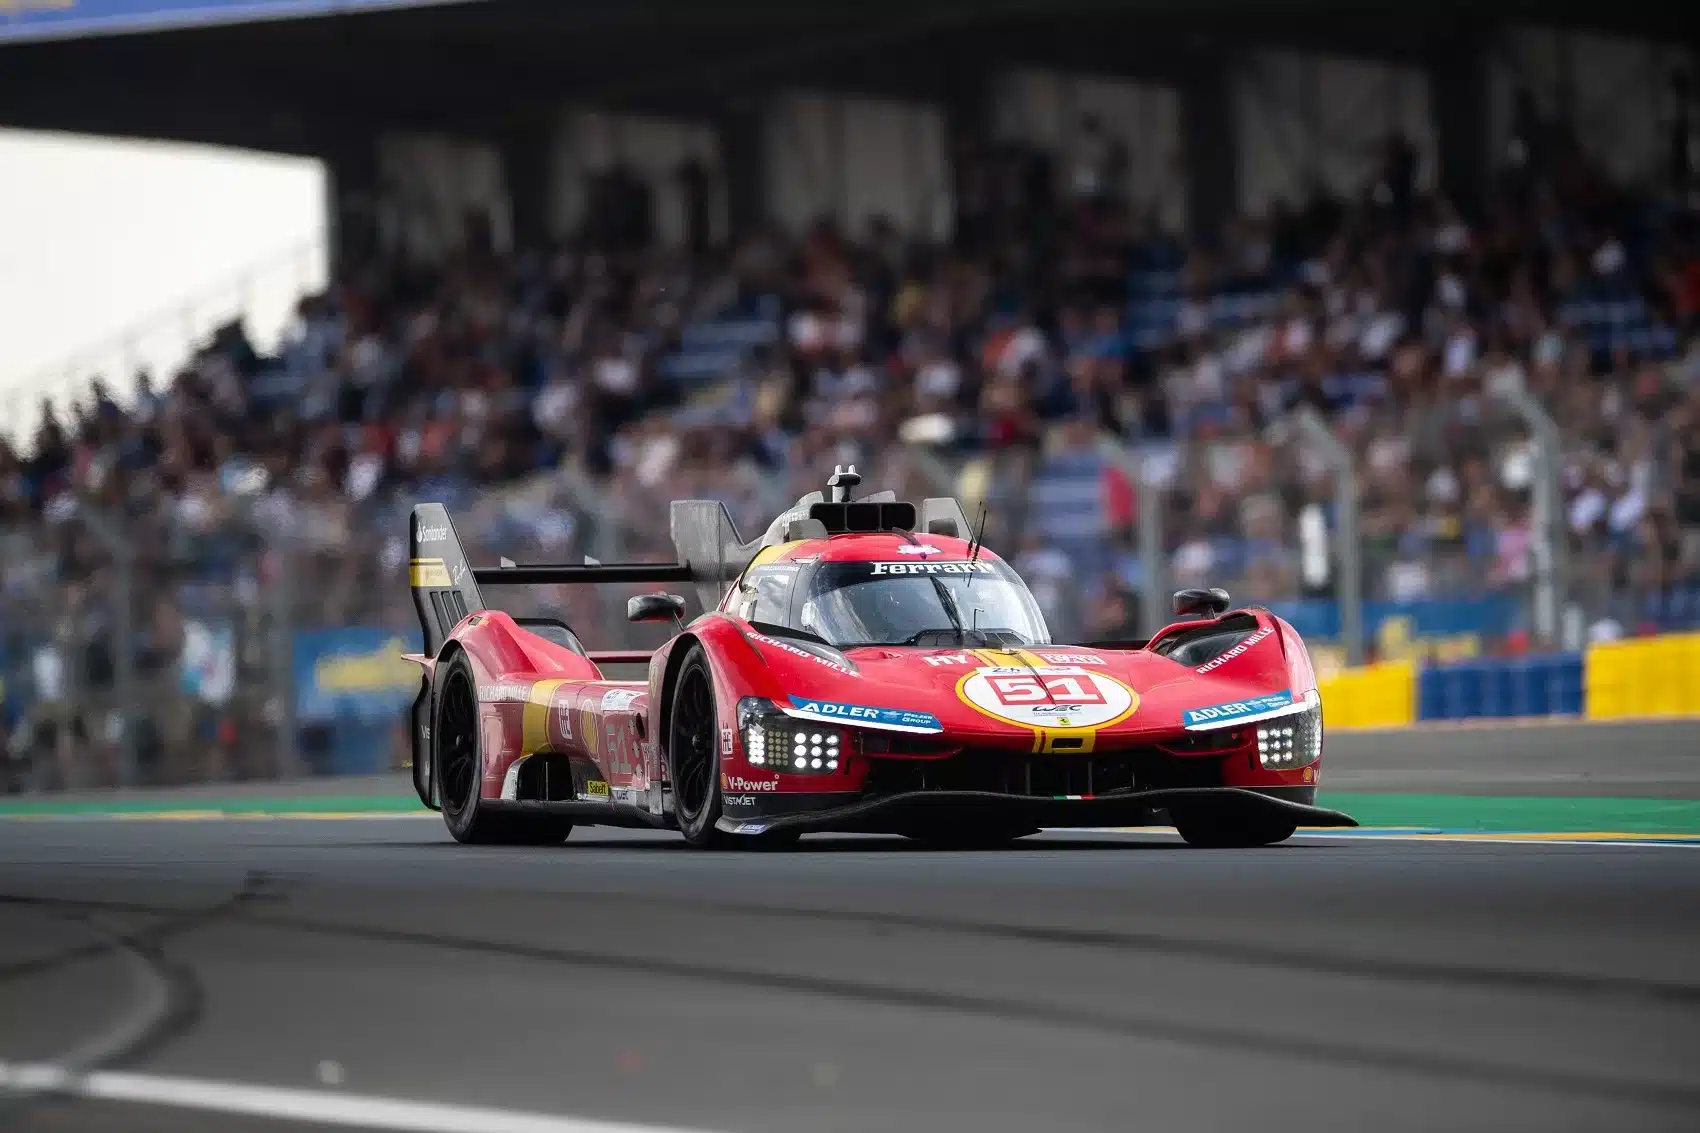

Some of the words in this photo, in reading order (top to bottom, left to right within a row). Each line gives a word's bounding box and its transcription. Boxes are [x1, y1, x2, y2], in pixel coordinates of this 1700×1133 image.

[422, 524, 448, 542] Santander
[870, 561, 995, 575] Ferrari
[746, 631, 811, 658] RICHARD
[812, 656, 862, 678] MILLE
[1195, 644, 1249, 674] RICHARD
[1243, 626, 1275, 646] MILLE
[923, 655, 968, 667] HY
[994, 676, 1099, 702] 51
[800, 702, 880, 719] ADLER
[1189, 702, 1252, 722] ADLER
[589, 781, 607, 797] Sabelt
[728, 776, 778, 791] V-Power
